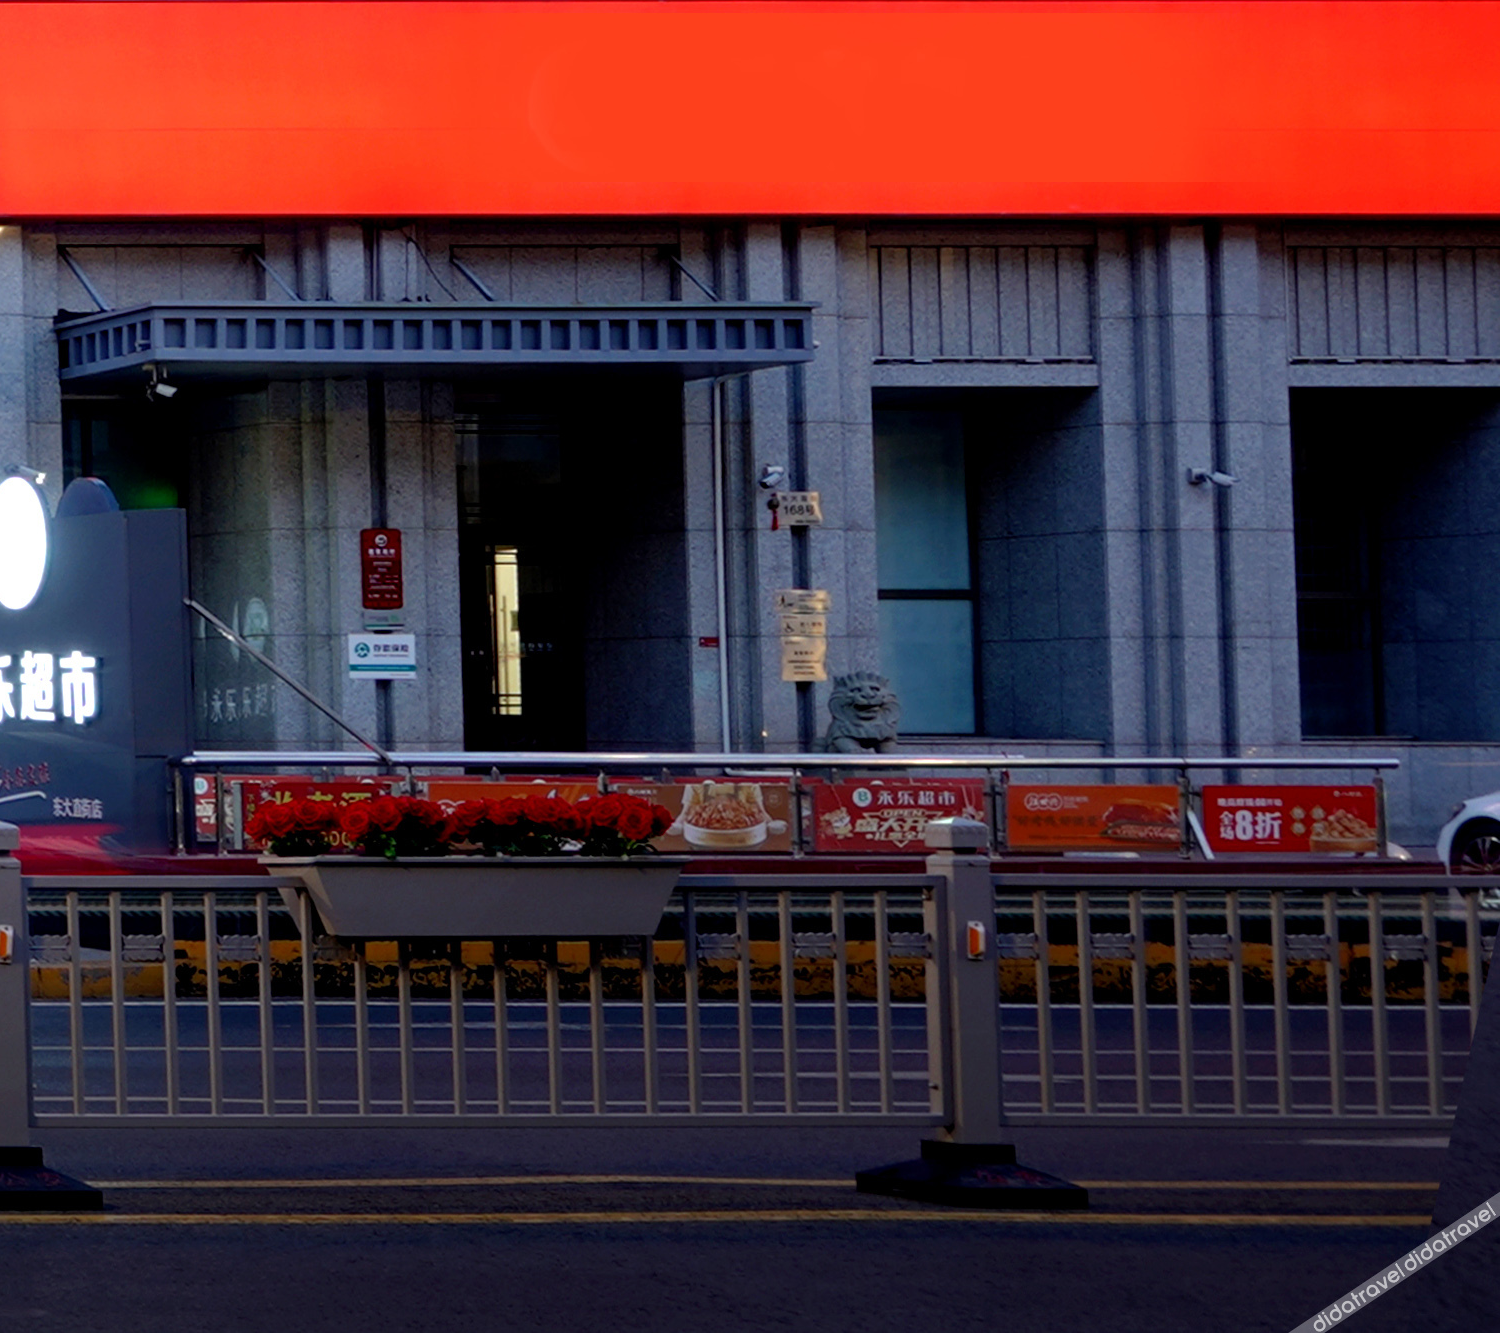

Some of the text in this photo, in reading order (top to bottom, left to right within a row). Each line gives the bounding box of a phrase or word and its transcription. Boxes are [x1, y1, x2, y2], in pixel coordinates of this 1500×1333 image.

[783, 504, 815, 516] 168号
[877, 790, 956, 806] 永乐超市
[52, 797, 103, 820] 东大直街店
[854, 817, 930, 832] 盛大开
[1235, 809, 1283, 841] 8折
